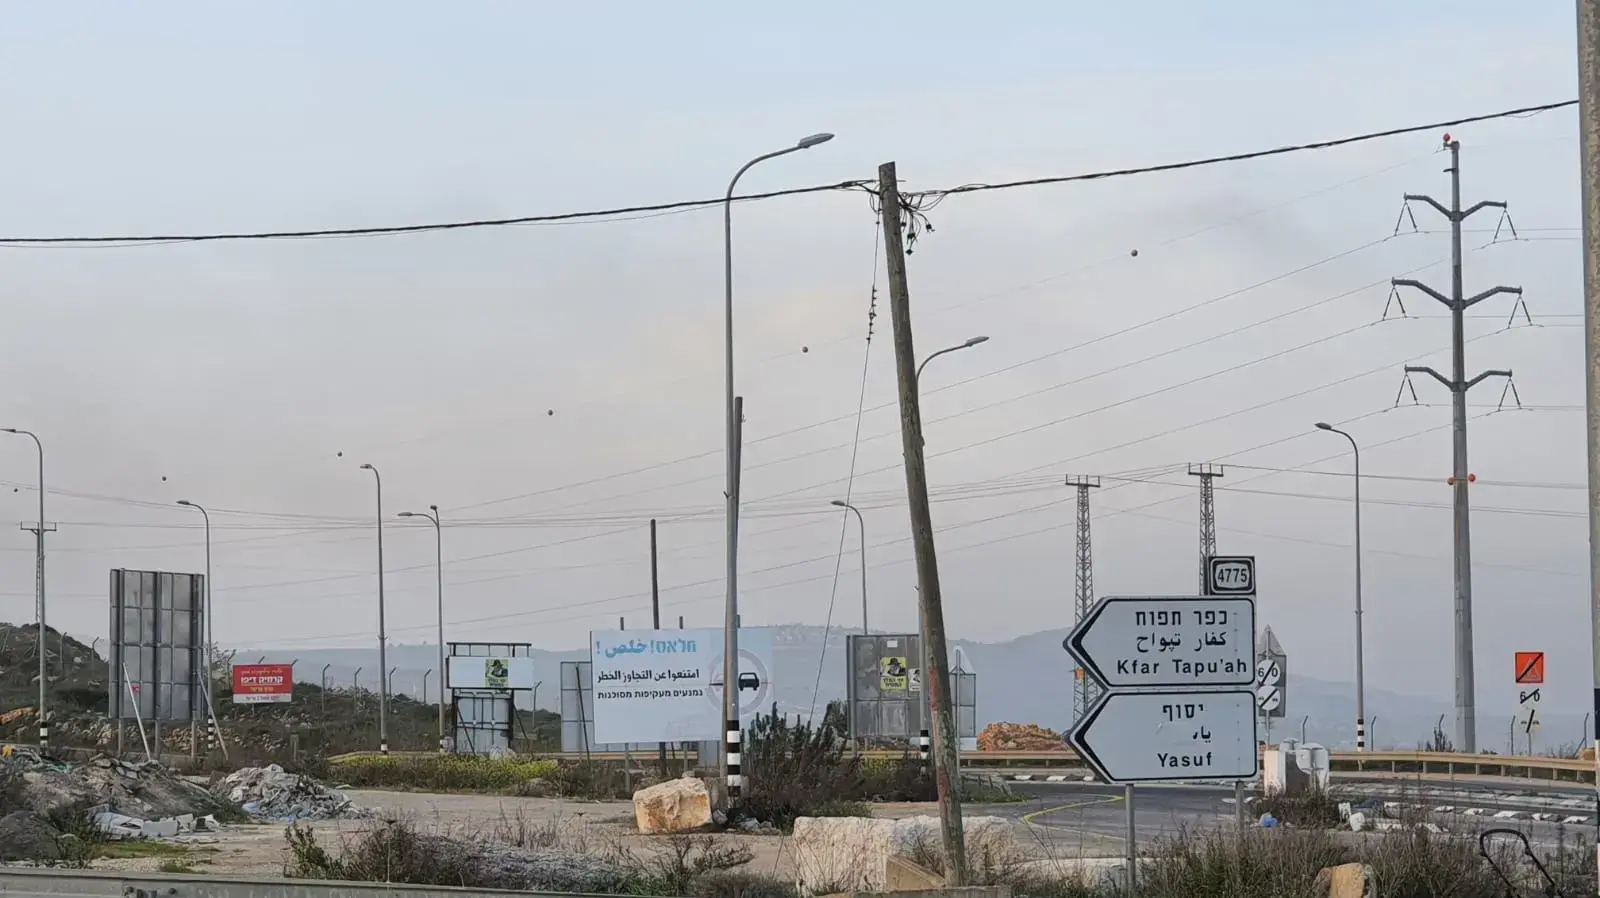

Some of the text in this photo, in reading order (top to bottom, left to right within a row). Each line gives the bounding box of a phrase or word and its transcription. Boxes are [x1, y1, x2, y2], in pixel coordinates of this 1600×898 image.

[1217, 568, 1248, 583] 4775
[1136, 610, 1228, 626] כפר תפוח
[1194, 632, 1227, 652] كفار
[1117, 659, 1247, 677] Kfar Tapu'ah
[654, 671, 667, 682] عن
[598, 688, 703, 699] נמנעים מעקיפות מסוכנות
[1162, 704, 1204, 722] יסוף
[1157, 752, 1212, 768] Yasuf
